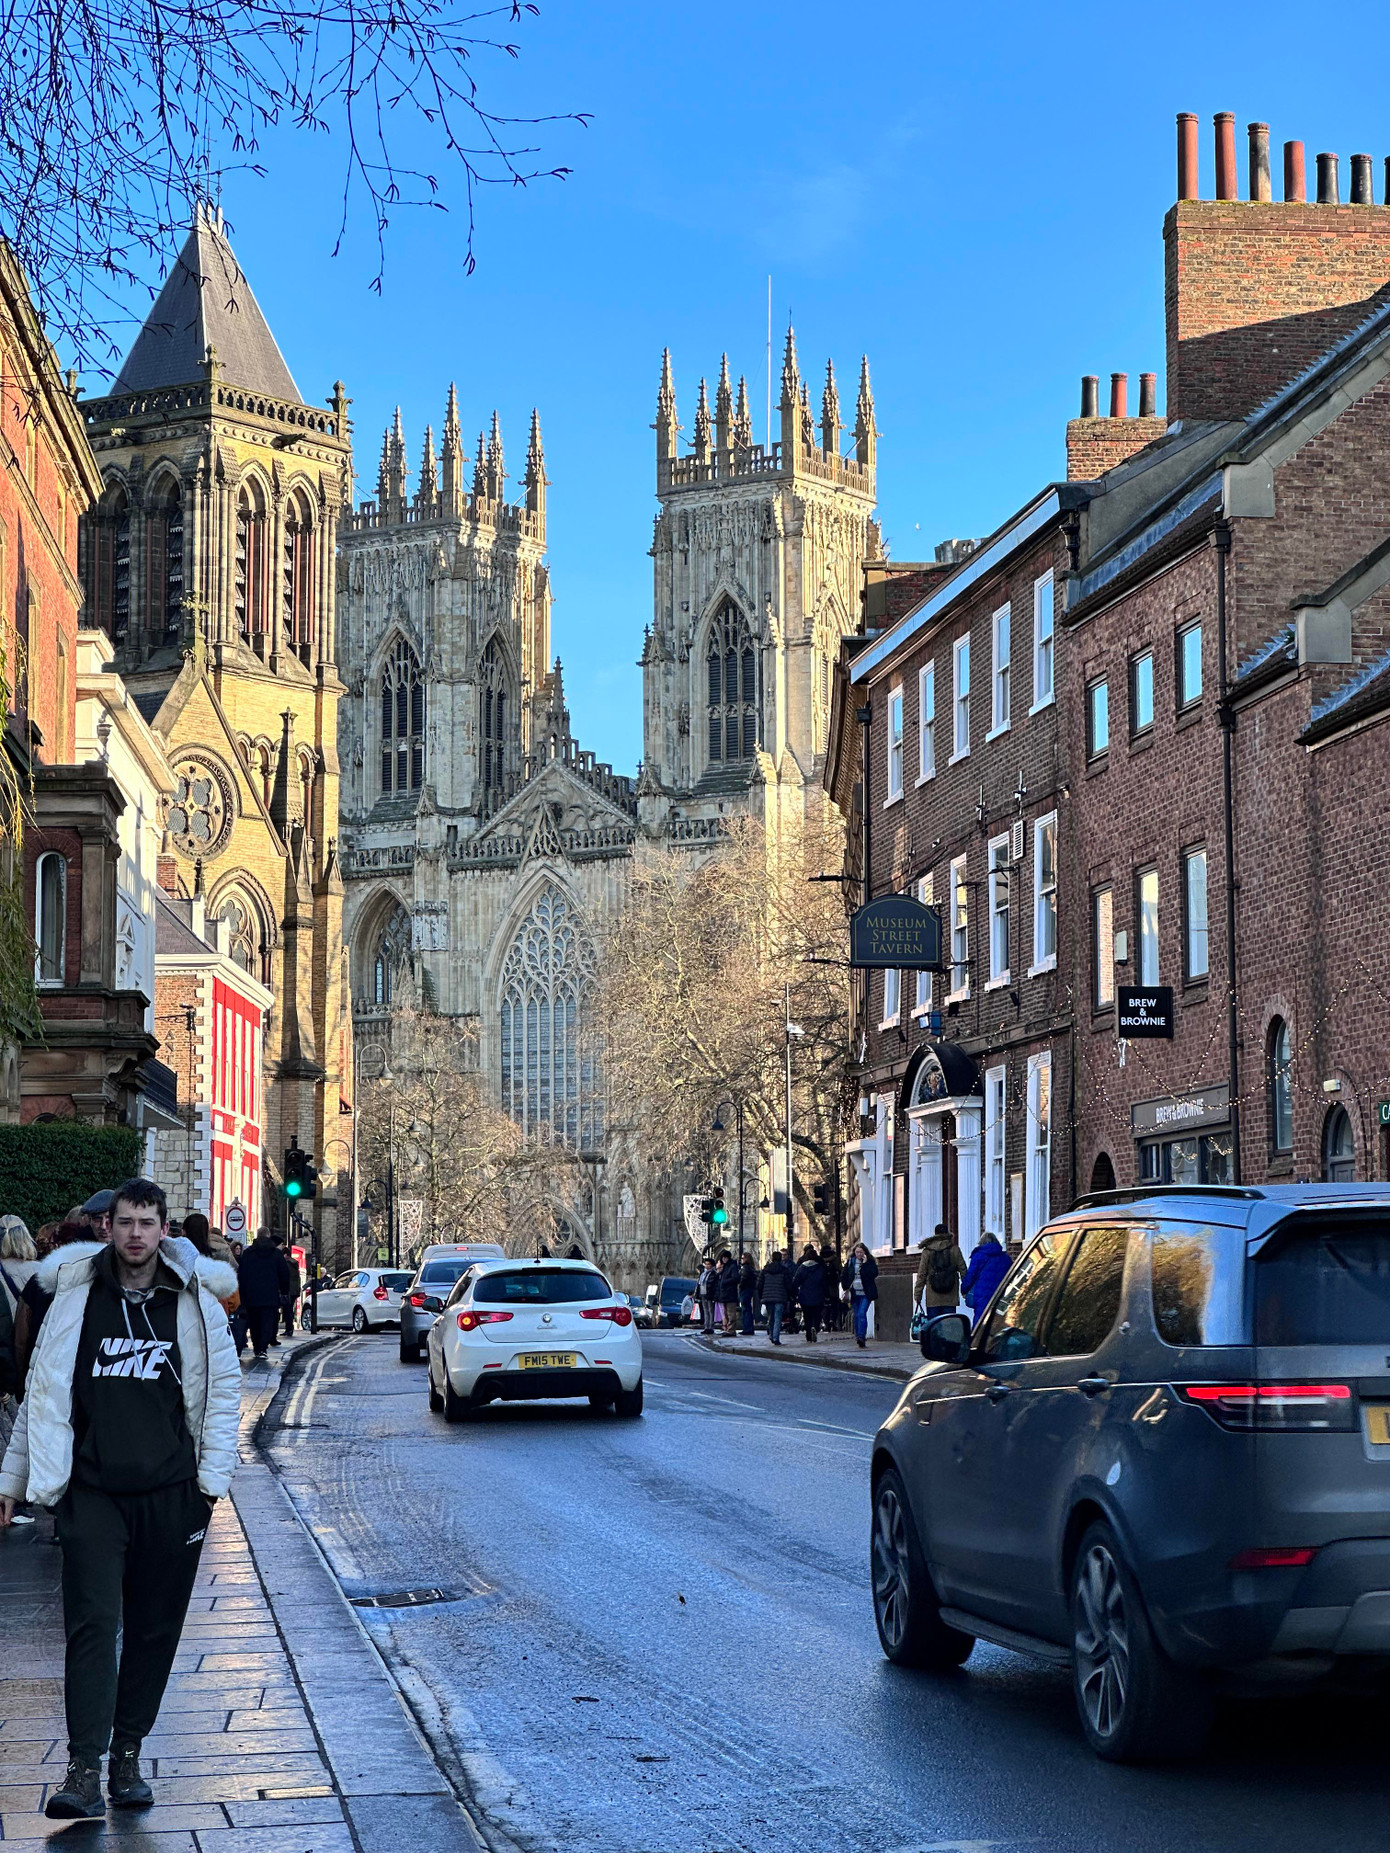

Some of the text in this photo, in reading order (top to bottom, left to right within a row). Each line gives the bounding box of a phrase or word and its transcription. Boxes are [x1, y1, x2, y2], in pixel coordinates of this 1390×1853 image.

[866, 916, 927, 929] MUSEUM
[872, 929, 921, 941] STREET
[869, 941, 923, 954] TAVERN
[1128, 998, 1157, 1007] BREW
[1139, 1007, 1147, 1016] &
[1120, 1016, 1166, 1026] BROWNIE
[1156, 1105, 1172, 1123] BREW
[92, 1337, 173, 1380] NIKE
[524, 1355, 571, 1366] FM15 TWE
